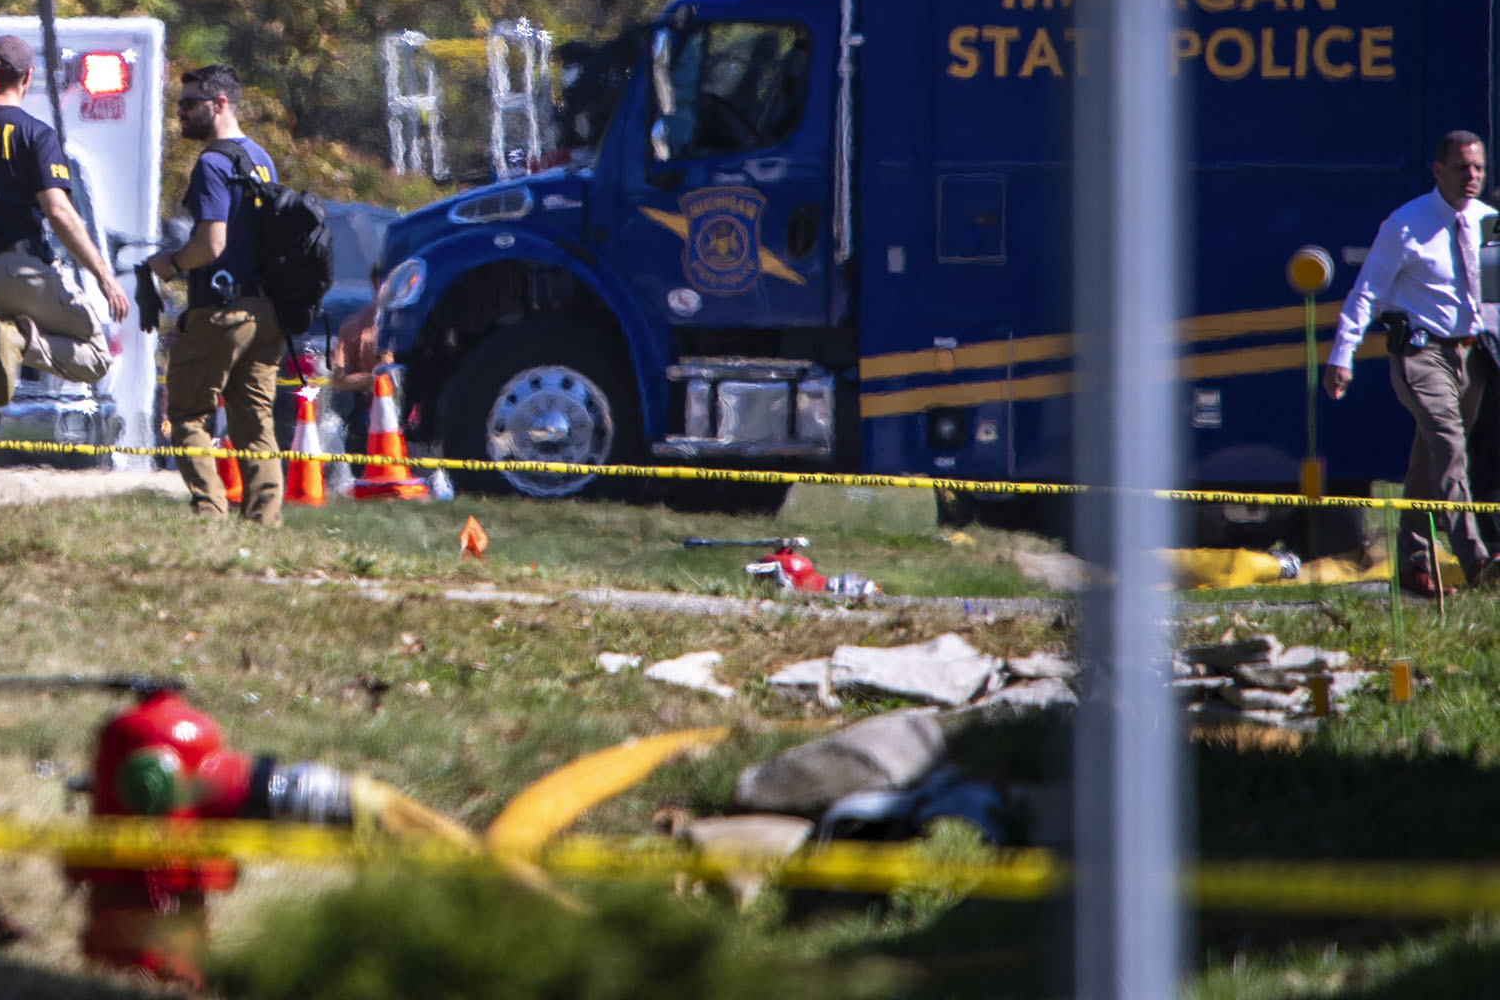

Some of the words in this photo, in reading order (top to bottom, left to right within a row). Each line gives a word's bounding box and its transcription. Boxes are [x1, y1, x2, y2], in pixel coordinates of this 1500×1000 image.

[947, 26, 1112, 80] STAT
[1168, 26, 1396, 80] POLICE
[50, 164, 70, 180] FBI
[695, 468, 732, 480] STATE
[974, 482, 1020, 492] POLICE
[1169, 491, 1207, 502] STATE
[1212, 494, 1259, 504] POLICE
[1411, 502, 1448, 512] STATE
